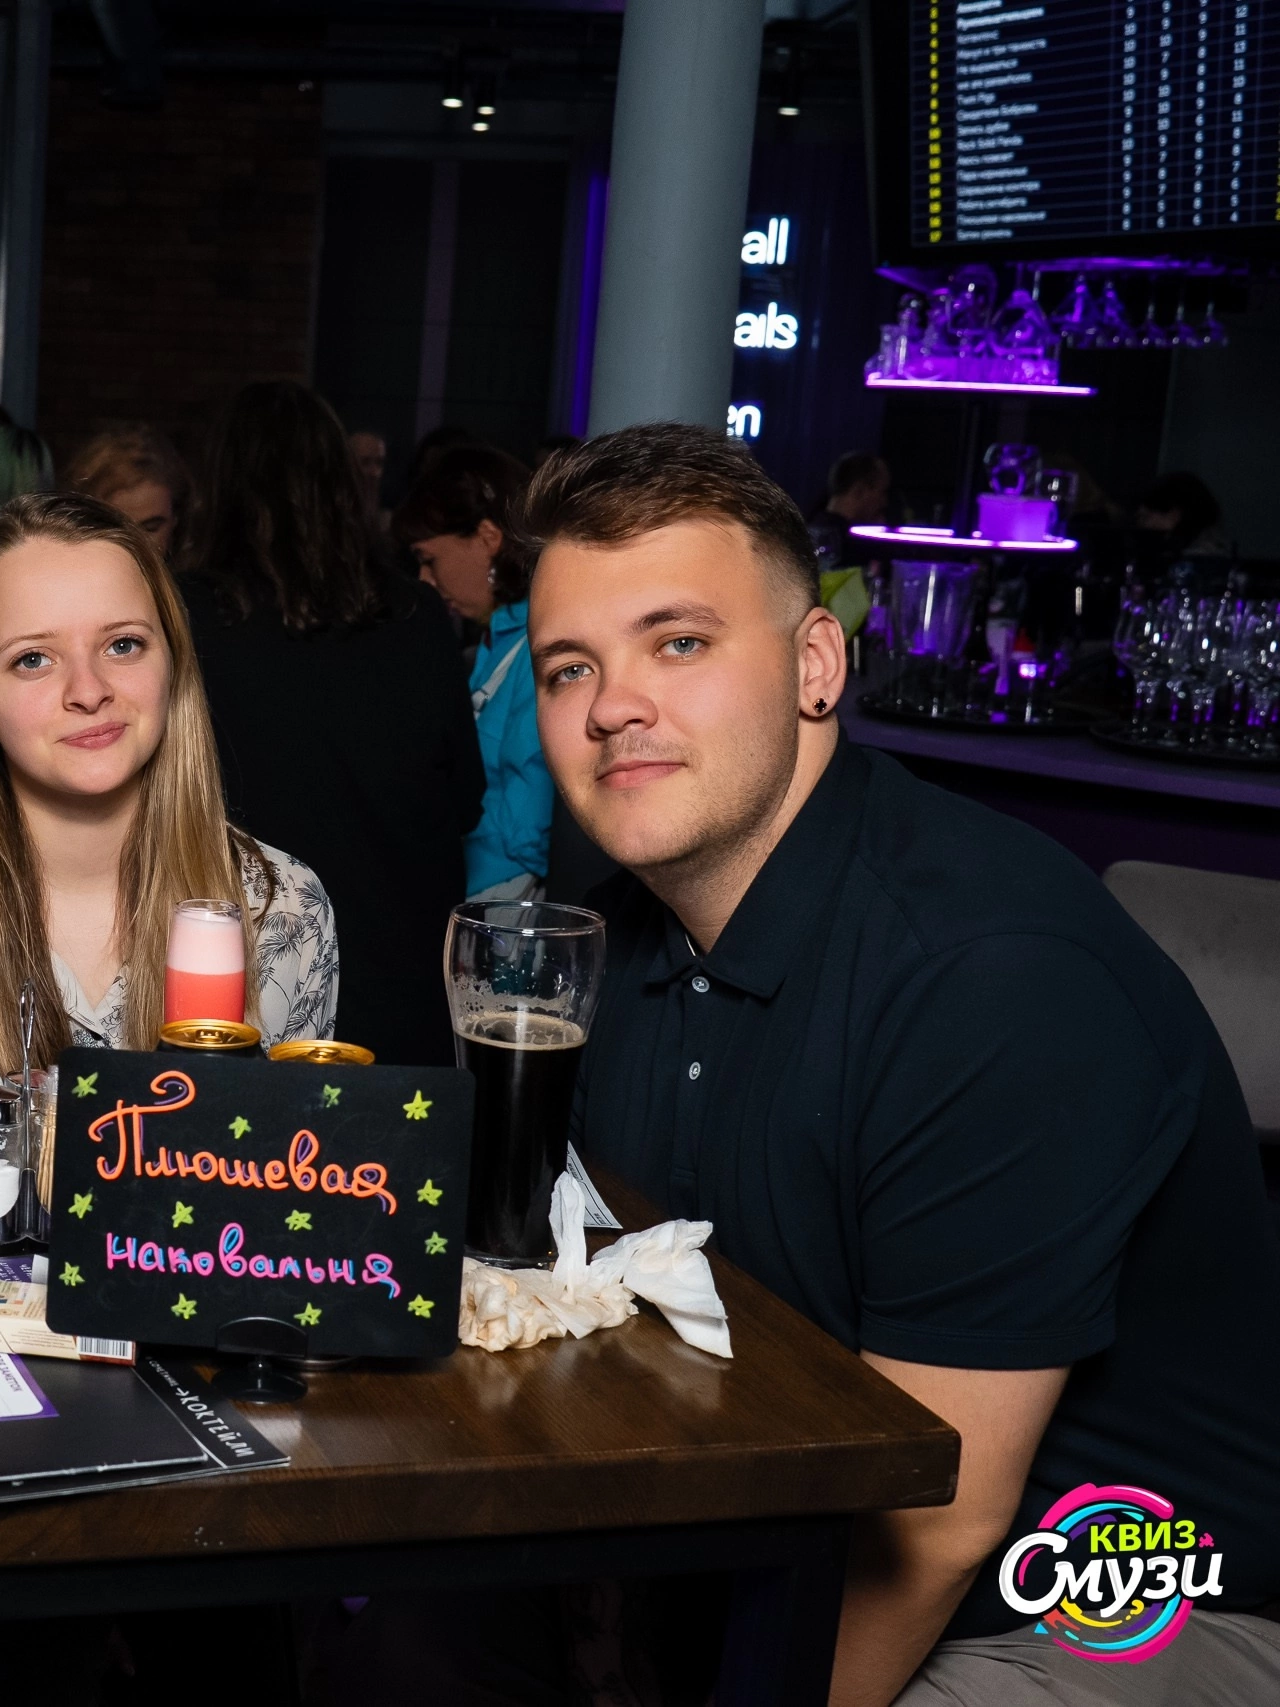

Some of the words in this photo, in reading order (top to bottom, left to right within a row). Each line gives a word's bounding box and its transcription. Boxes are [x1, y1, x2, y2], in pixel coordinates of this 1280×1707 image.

[741, 217, 790, 265] all
[88, 1070, 397, 1216] Плюшевая
[106, 1222, 401, 1300] наковальня
[180, 1395, 256, 1458] КОКТЕЙЛИ
